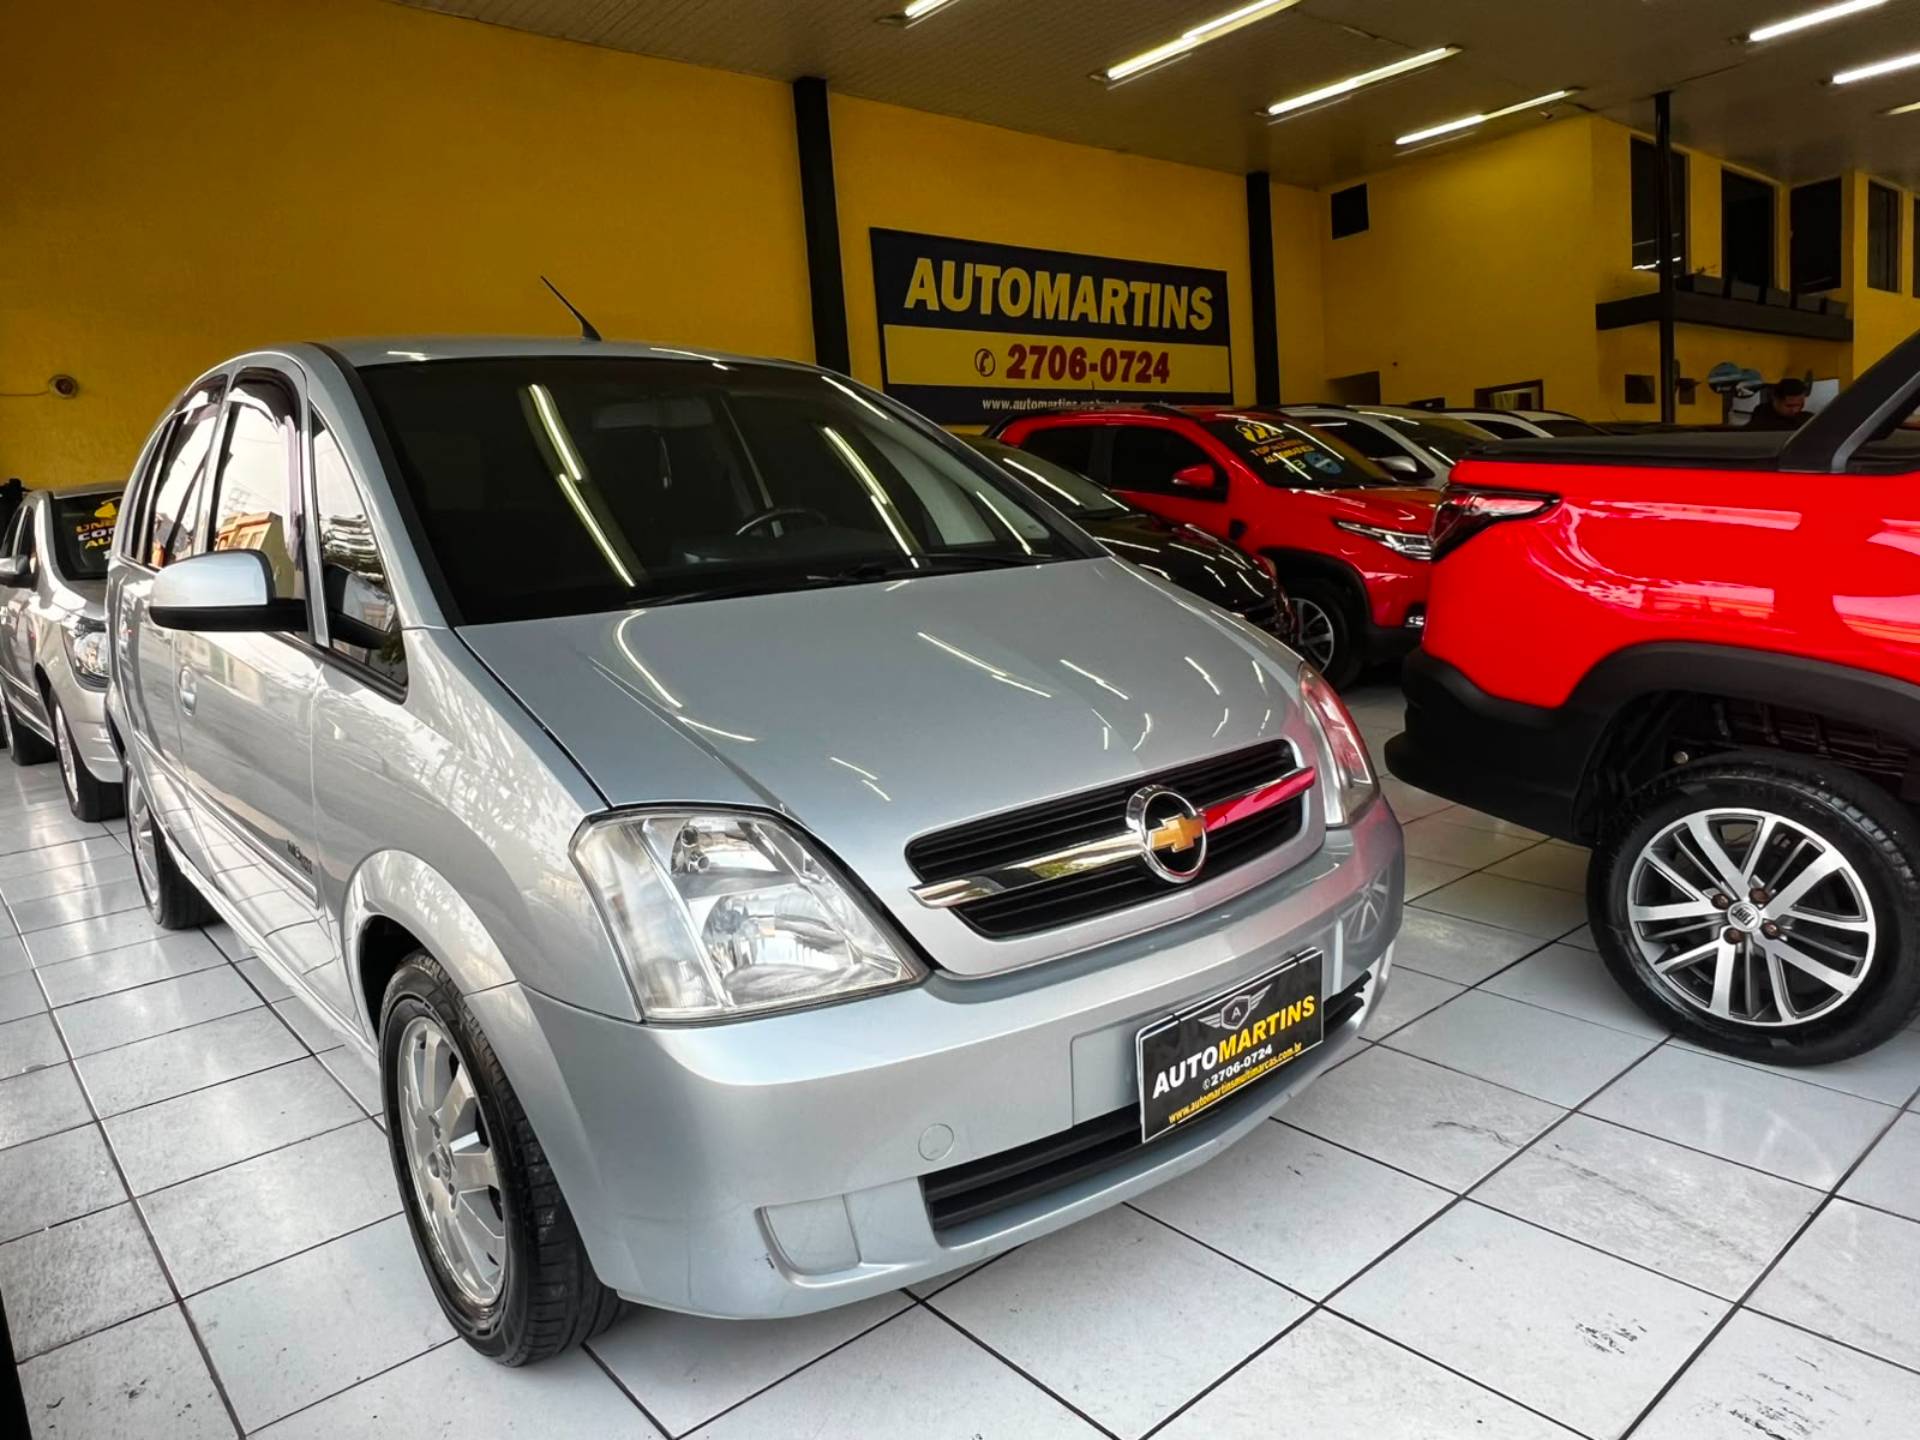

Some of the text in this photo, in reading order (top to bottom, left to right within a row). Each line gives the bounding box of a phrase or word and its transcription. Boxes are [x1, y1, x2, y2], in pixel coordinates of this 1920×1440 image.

[903, 257, 1214, 331] AUTOMARTINS
[1005, 344, 1171, 384] 2706-0724
[1152, 994, 1316, 1100] AUTOMARTINS
[1210, 1043, 1273, 1089] 2706-0724
